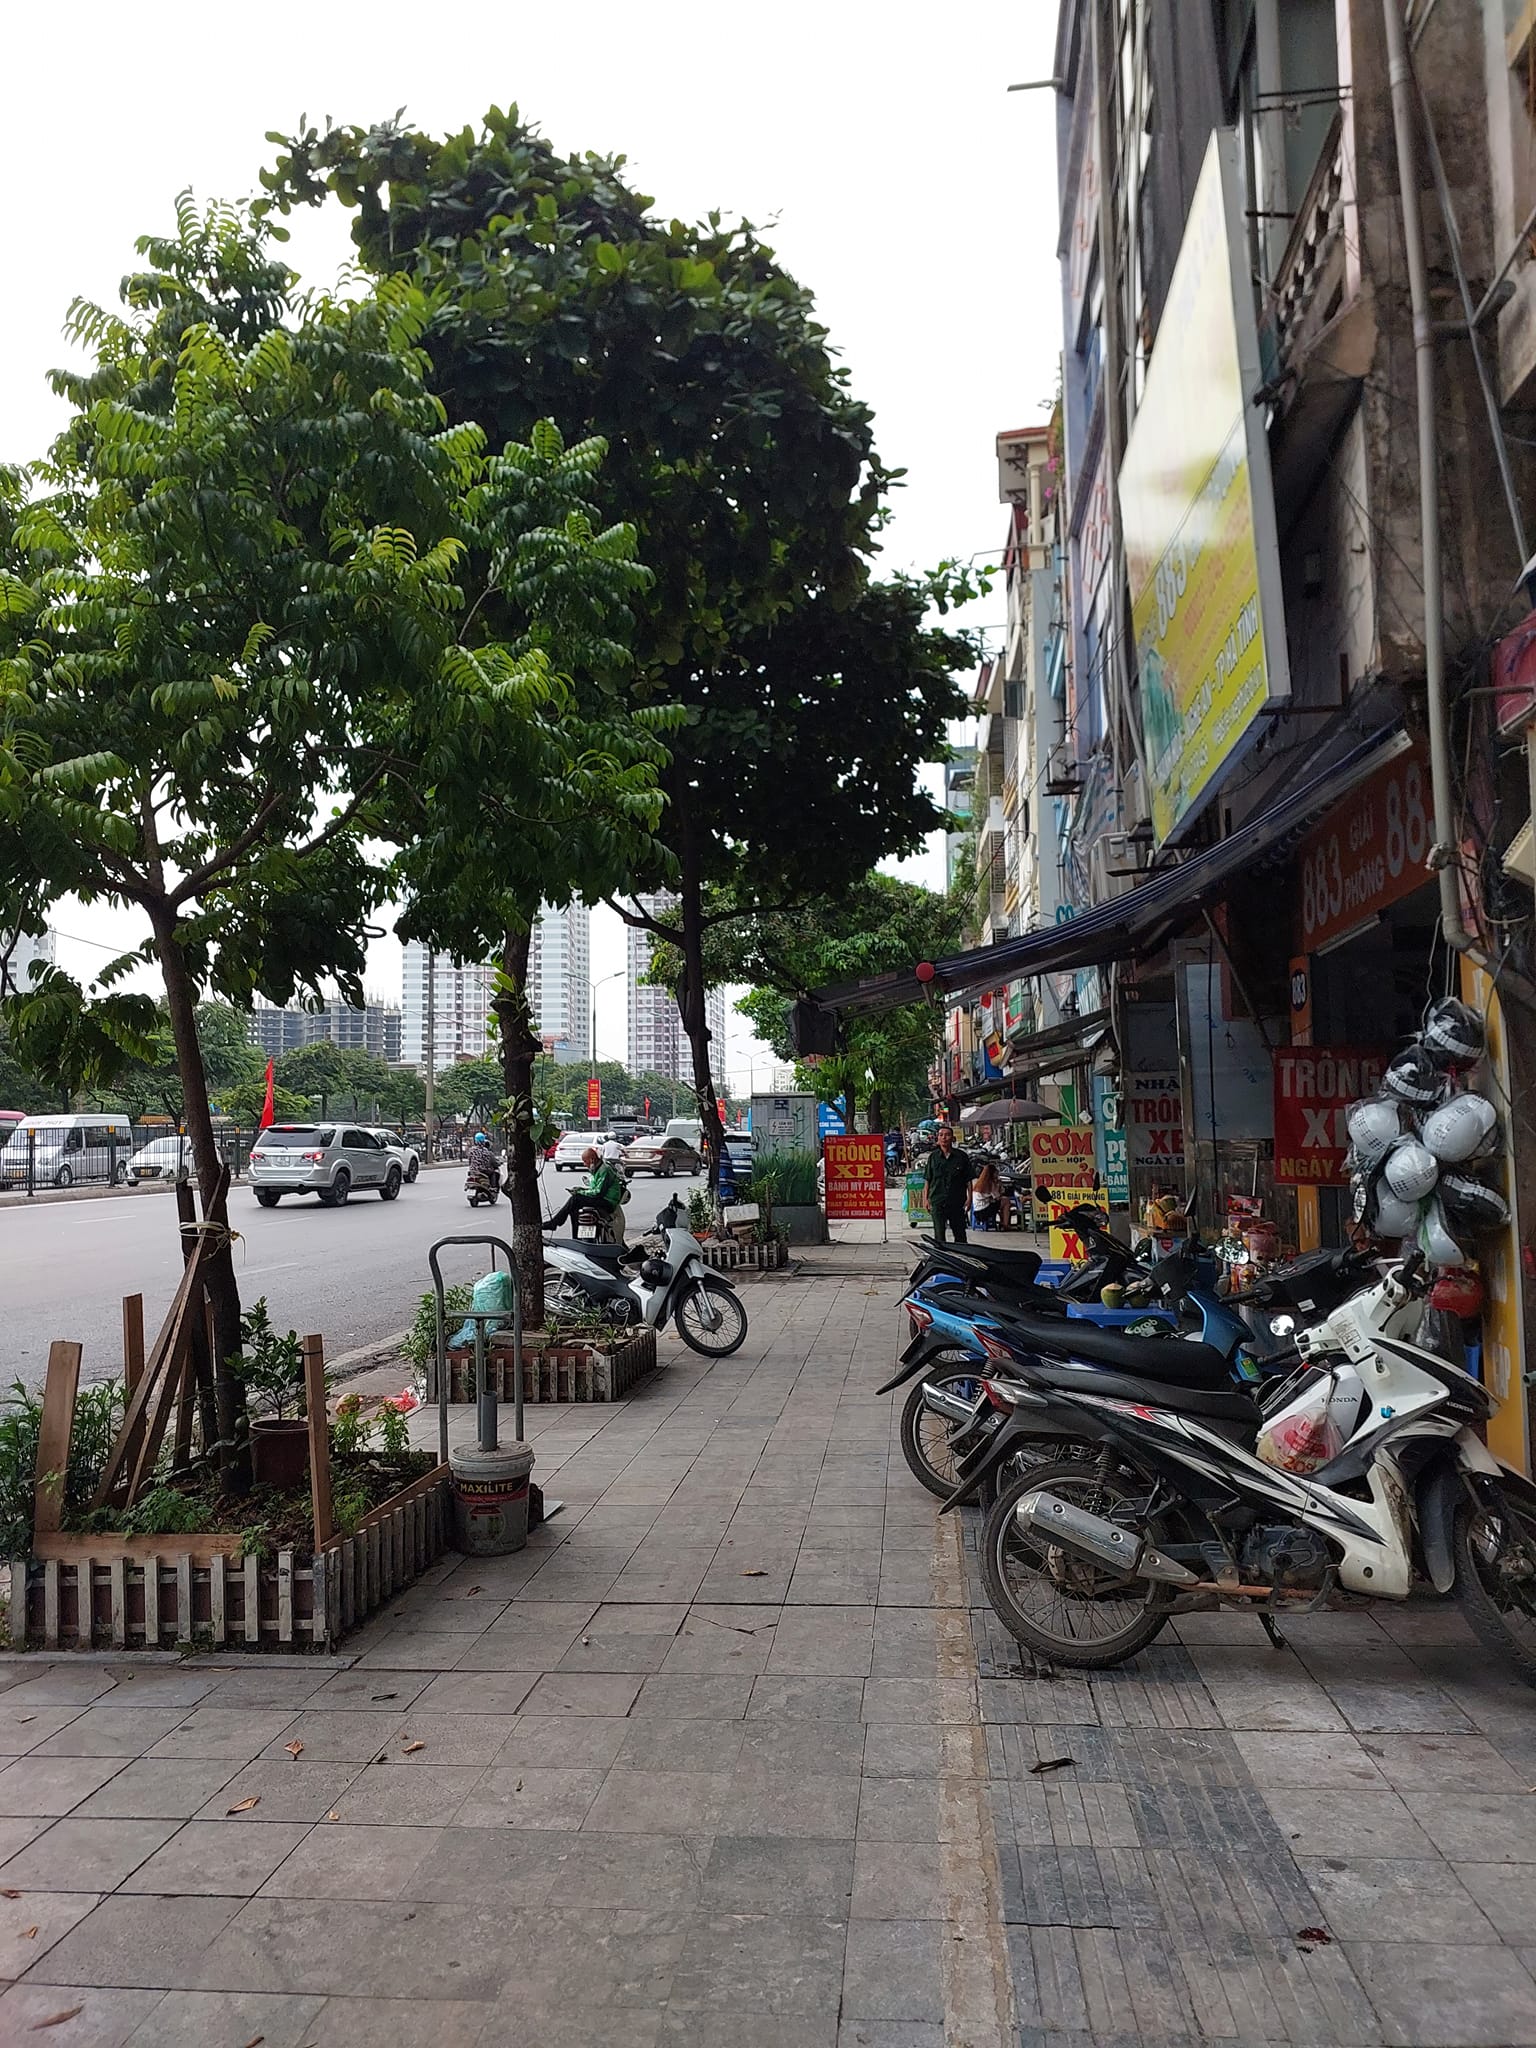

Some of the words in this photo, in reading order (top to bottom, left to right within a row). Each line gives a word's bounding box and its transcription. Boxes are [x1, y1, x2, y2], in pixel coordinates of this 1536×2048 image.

[1303, 833, 1342, 935] 883
[1279, 1051, 1381, 1098] TRÔNG
[827, 1142, 882, 1162] TRÔNG
[1032, 1128, 1094, 1156] CƠM
[833, 1164, 875, 1179] XE
[1280, 1156, 1334, 1178] NGÀY
[864, 1181, 882, 1192] PATE
[1051, 1190, 1066, 1200] 881
[460, 1481, 513, 1494] MAXILITE
